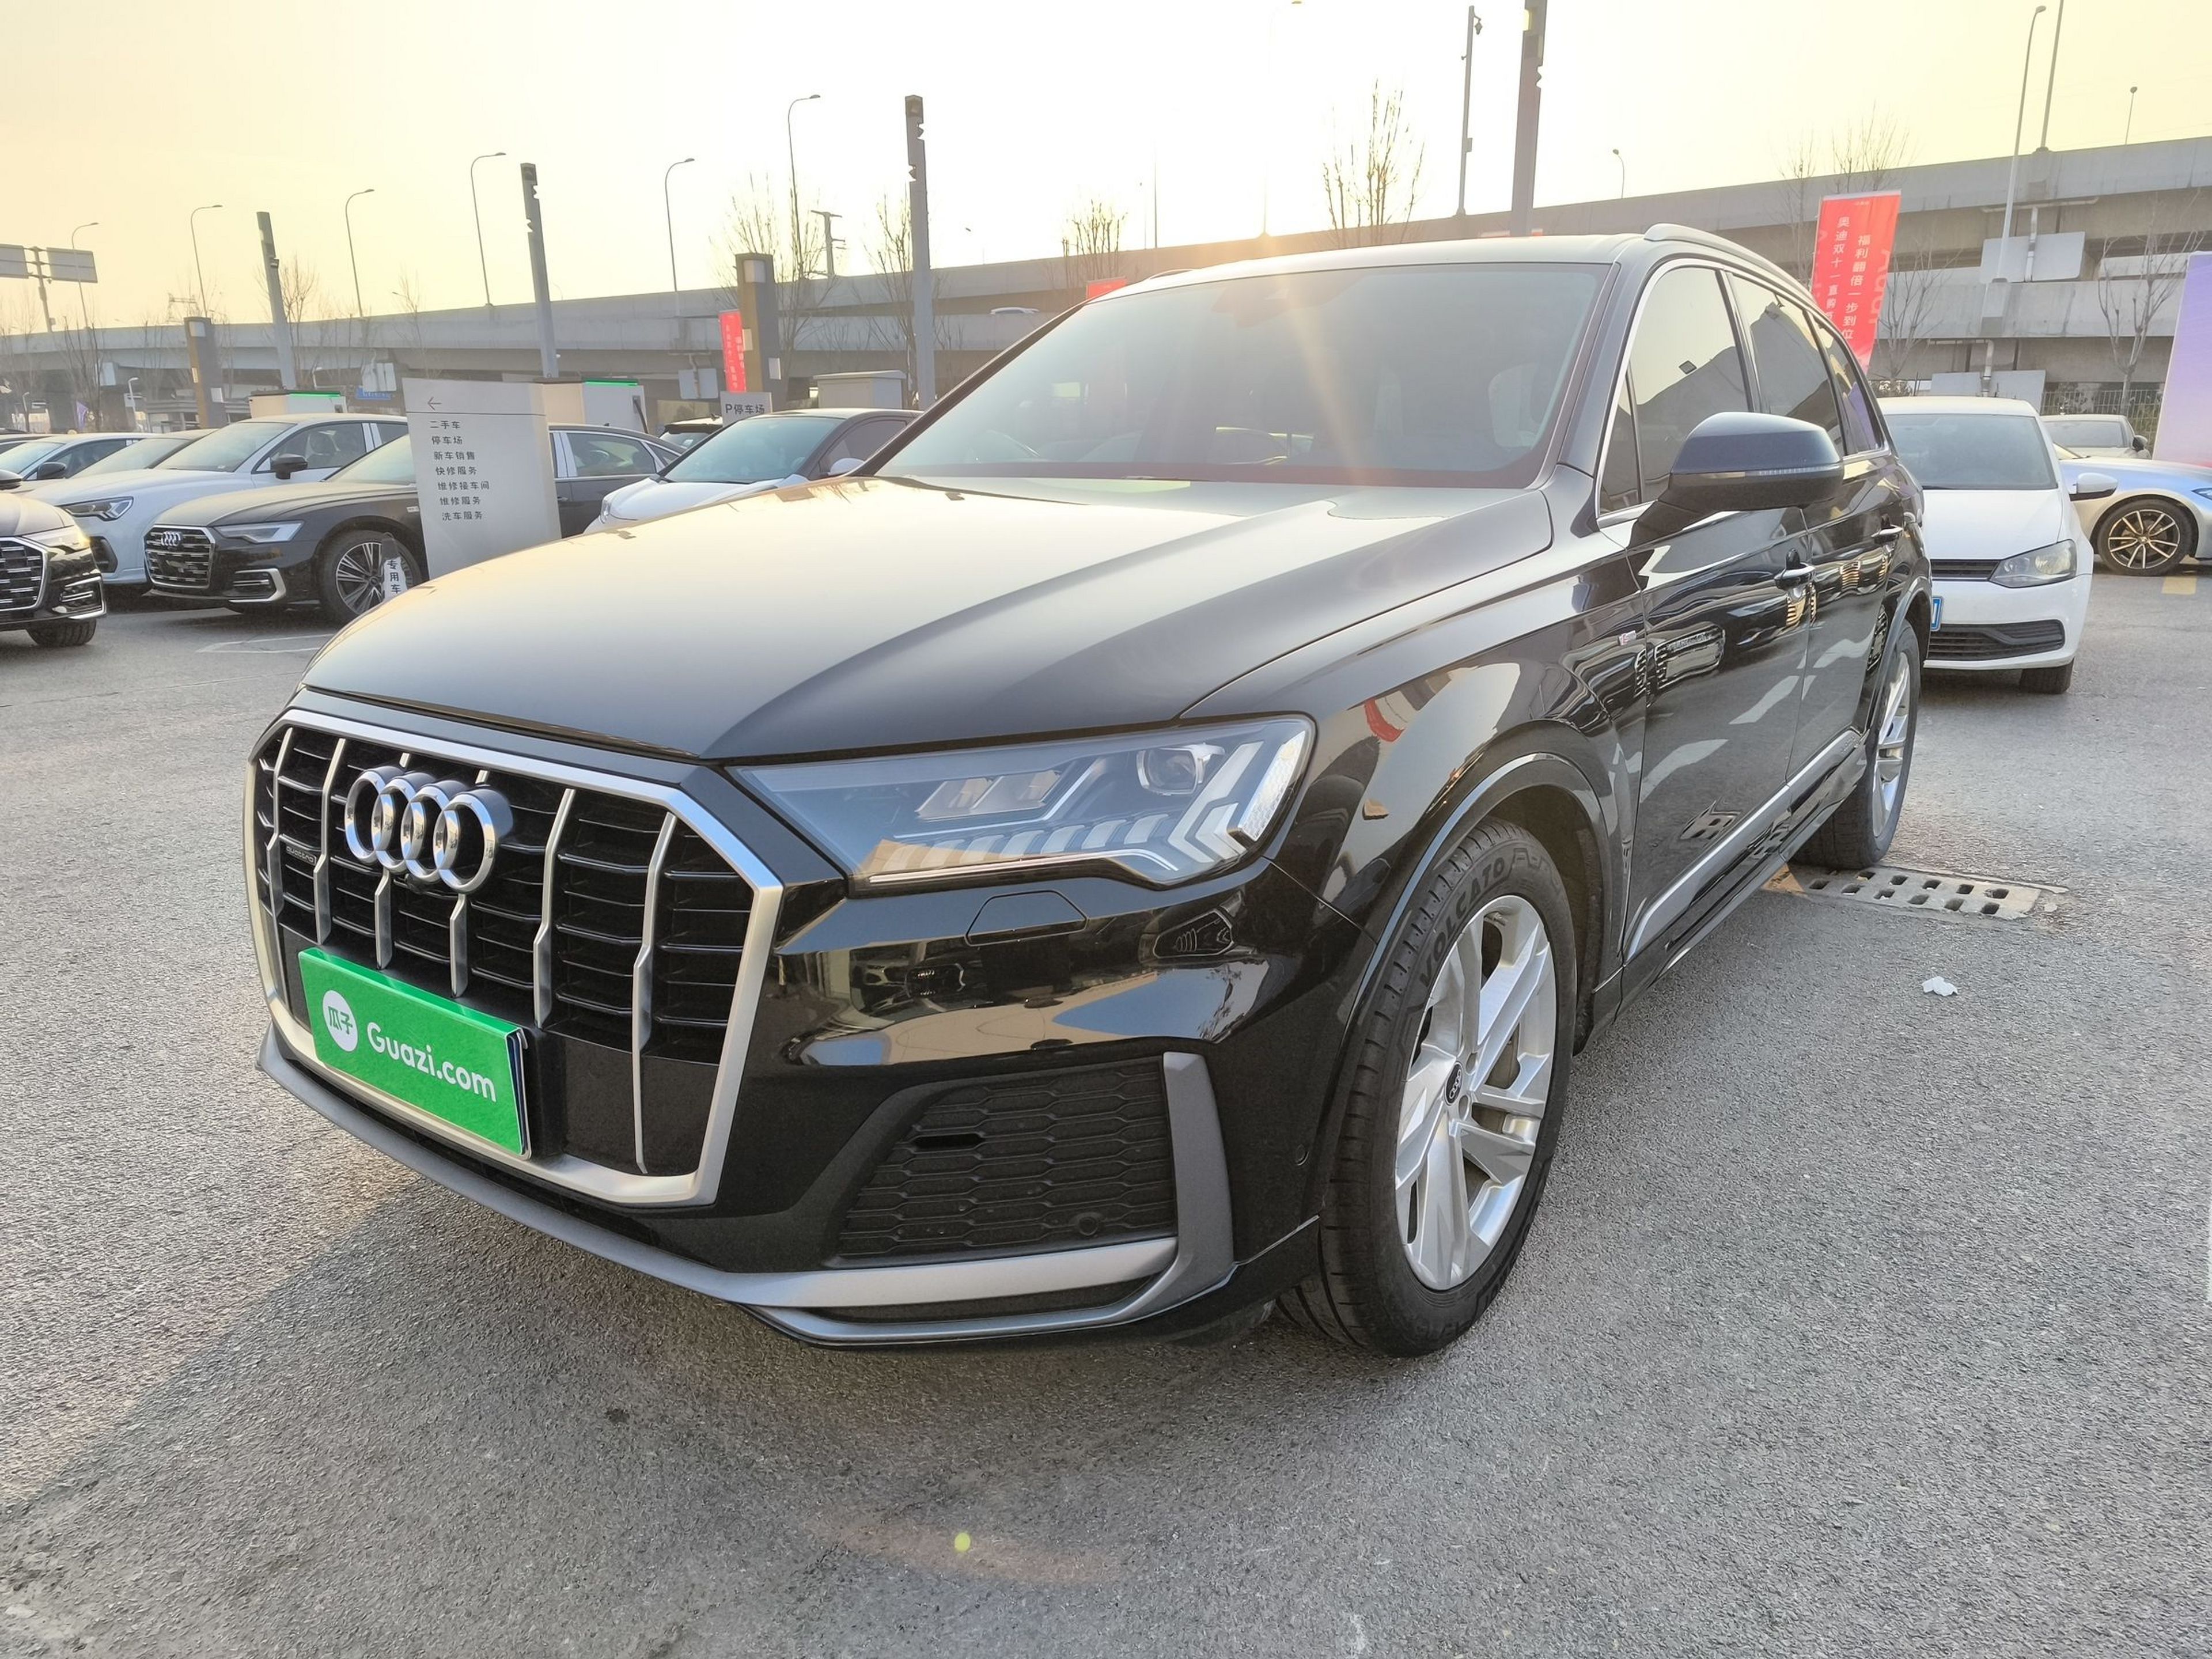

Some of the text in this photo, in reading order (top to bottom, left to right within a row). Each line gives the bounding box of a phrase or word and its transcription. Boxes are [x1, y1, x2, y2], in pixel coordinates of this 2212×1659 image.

[1842, 235, 1870, 339] 福利翻倍一步到位
[430, 421, 461, 429] 二手车
[431, 436, 463, 444] 停车场
[434, 452, 475, 460] 新车销售
[435, 467, 477, 475] 快修服务
[440, 497, 480, 505] 维修服务
[442, 511, 483, 521] 洗车服务
[387, 560, 402, 594] 专用车
[328, 1006, 353, 1035] 瓜子
[367, 1022, 497, 1103] Guazi.com
